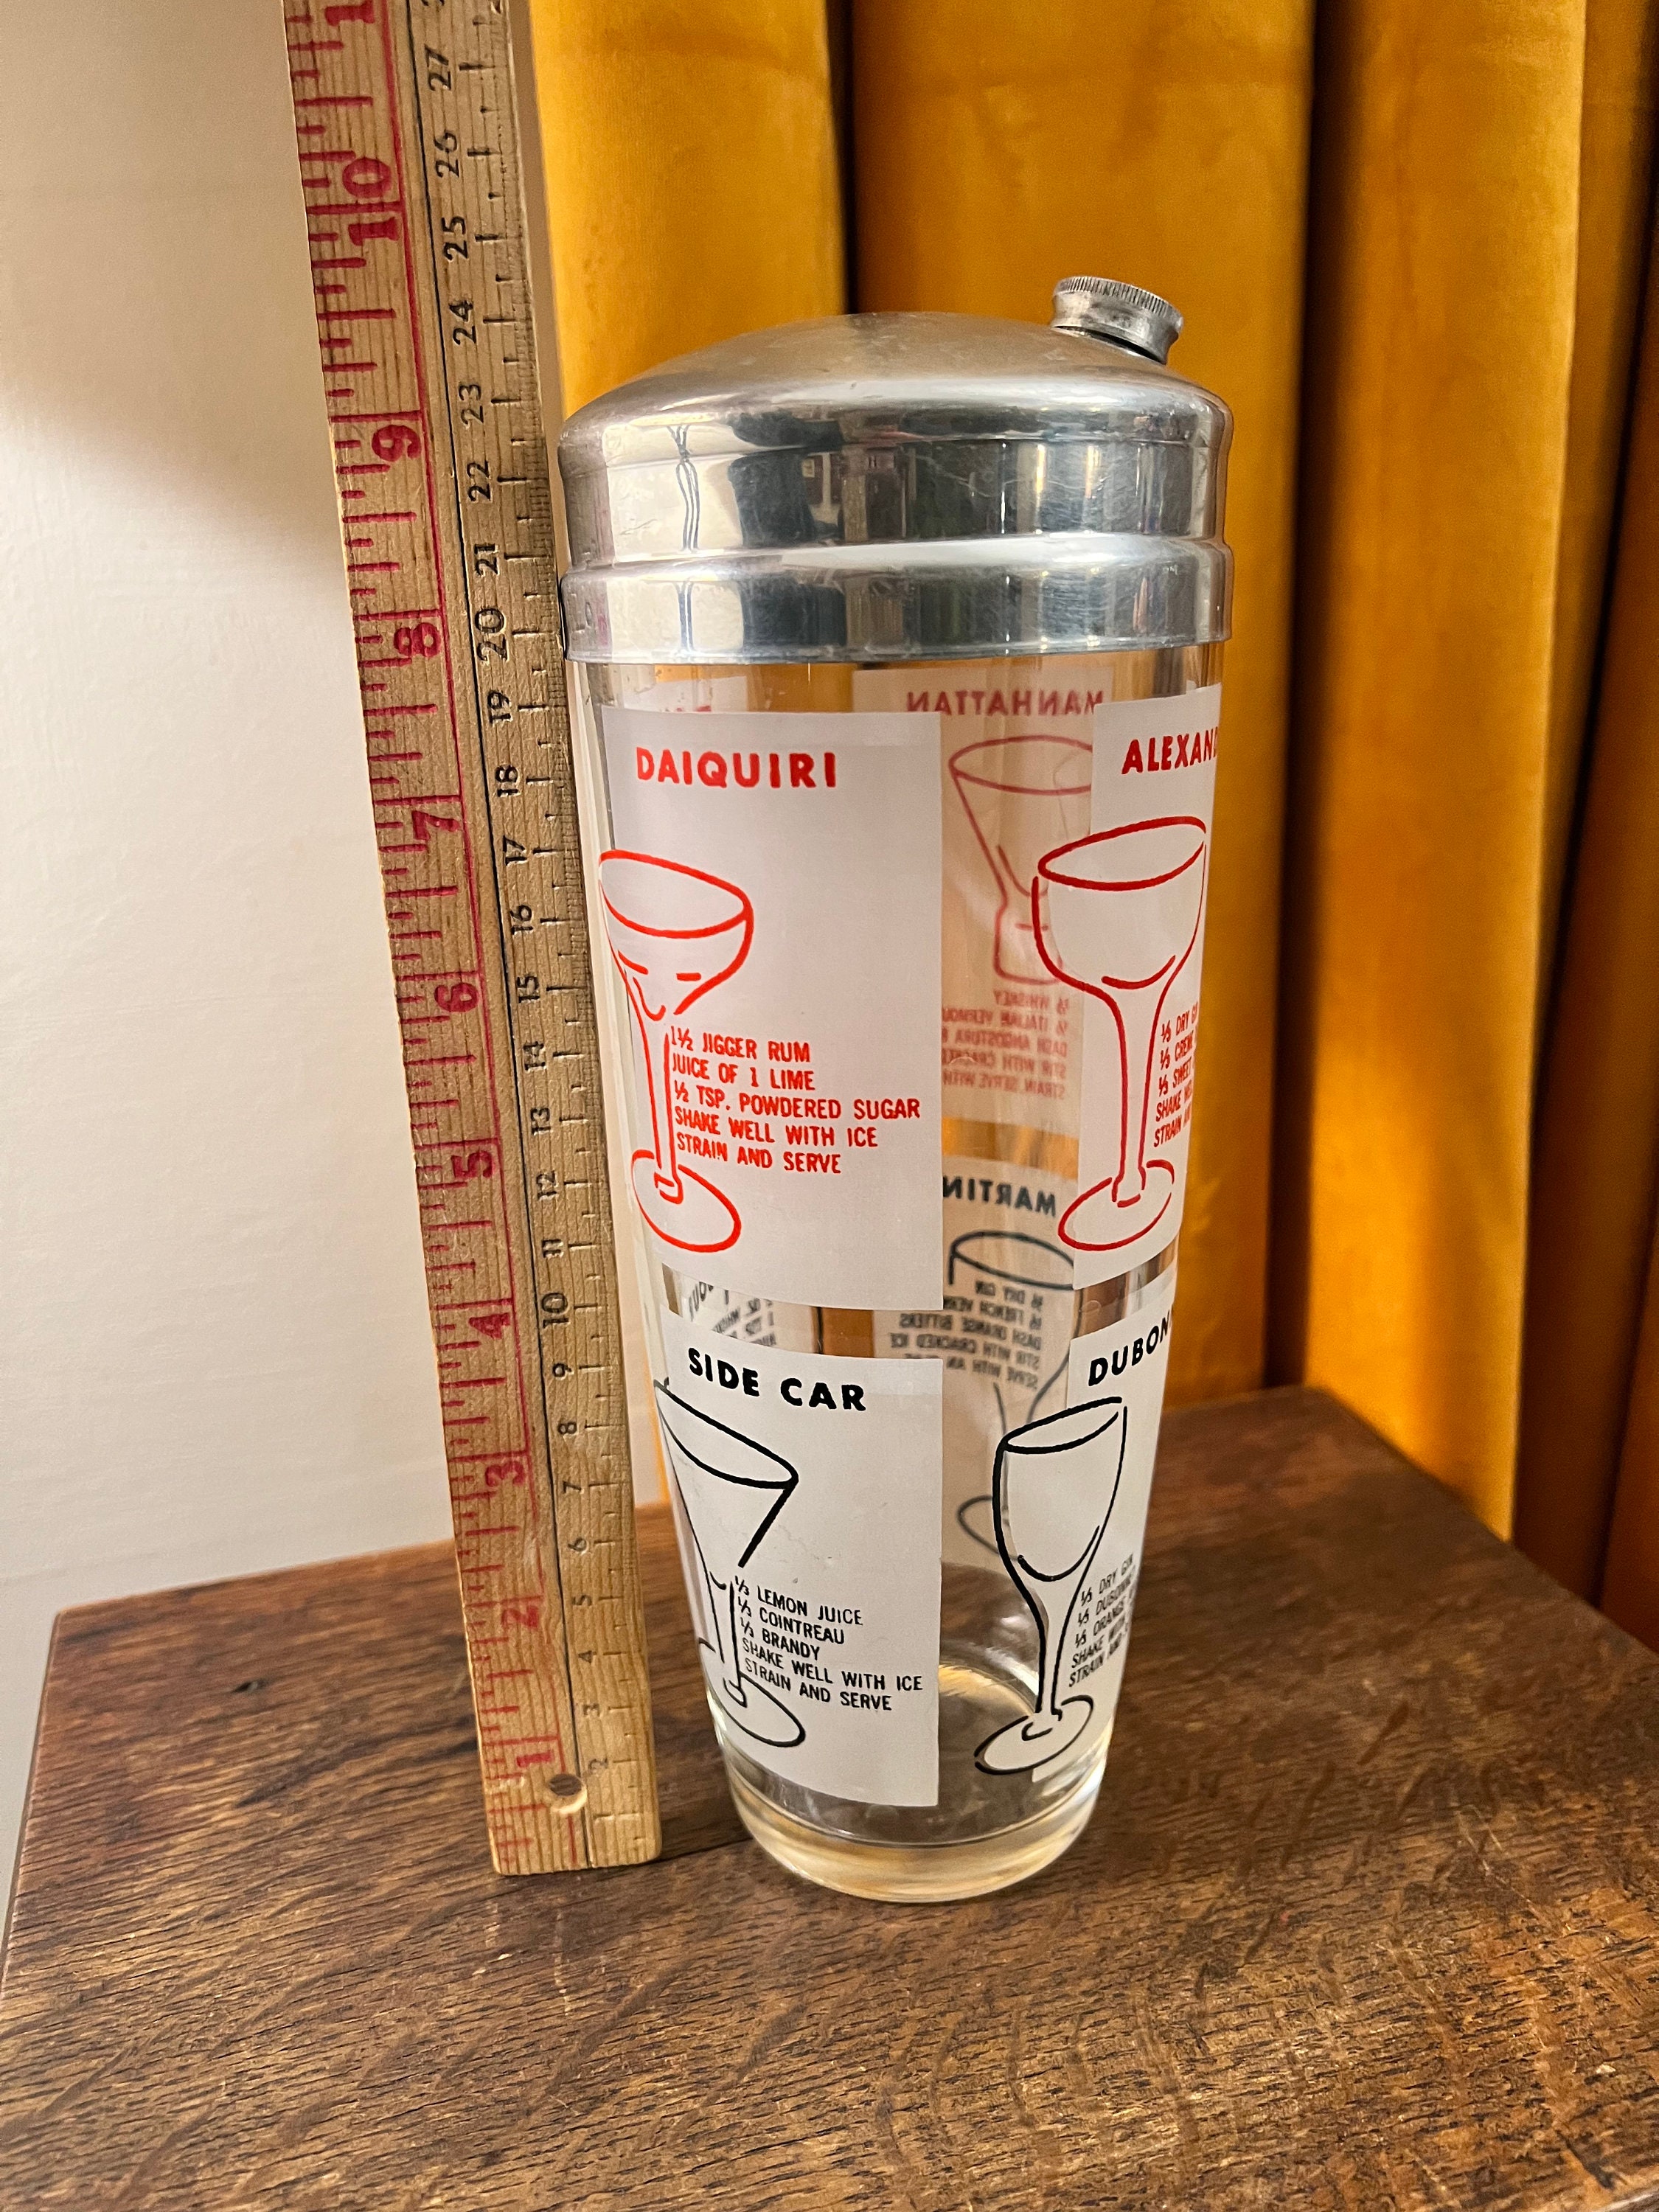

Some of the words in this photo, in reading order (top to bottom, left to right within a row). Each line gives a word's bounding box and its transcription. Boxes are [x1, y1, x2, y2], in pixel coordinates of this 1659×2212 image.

[324, 1, 375, 27] 1
[424, 44, 452, 91] 27
[434, 130, 459, 177] 26
[342, 157, 399, 246] 10
[442, 215, 468, 262] 25
[448, 299, 476, 345] 24
[458, 383, 484, 428] 23
[372, 424, 422, 462] 9
[467, 460, 491, 502] 22
[475, 543, 498, 577] 21
[393, 622, 441, 658] 8
[475, 608, 509, 661] 20
[487, 689, 512, 724] 19
[495, 765, 521, 798] 18
[636, 746, 836, 789] DAIQUIRI
[411, 810, 461, 841] 7
[502, 835, 528, 866] 17
[509, 904, 533, 935] 16
[434, 981, 479, 1013] 6
[517, 975, 540, 1004] 15
[1175, 1009, 1189, 1036] DRY
[523, 1040, 547, 1072] 14
[703, 1032, 757, 1060] JIGGER
[768, 1040, 810, 1062] RUM
[672, 1052, 710, 1080] JUICE
[718, 1063, 738, 1084] OF
[750, 1067, 759, 1088] 1
[770, 1068, 815, 1091] LIME
[696, 1085, 731, 1111] TSP.
[739, 1092, 841, 1119] POWDERED
[853, 1098, 920, 1120] SUGAR
[1155, 1090, 1182, 1122] SHAKE
[530, 1107, 551, 1135] 13
[675, 1105, 720, 1135] SHAKE
[728, 1116, 776, 1144] WELL
[785, 1124, 835, 1147] WITH
[847, 1127, 878, 1147] ICE
[1154, 1114, 1182, 1147] STRAIN
[451, 1150, 494, 1178] 5
[676, 1132, 728, 1162] STRAIN
[737, 1146, 773, 1169] AND
[784, 1151, 841, 1174] SERVE
[537, 1169, 559, 1201] 12
[542, 1238, 564, 1259] 11
[468, 1312, 511, 1340] 4
[541, 1292, 569, 1328] 10
[552, 1362, 573, 1378] 9
[688, 1347, 759, 1397] SIDE
[780, 1377, 866, 1411] CAR
[557, 1422, 577, 1436] 8
[484, 1460, 525, 1487] 3
[563, 1481, 583, 1495] 7
[568, 1537, 588, 1553] 6
[1099, 1568, 1118, 1594] DRY
[501, 1605, 540, 1630] 2
[572, 1595, 593, 1607] 5
[757, 1585, 807, 1617] LEMON
[817, 1605, 863, 1626] JUICE
[759, 1607, 845, 1645] COINTREAU
[577, 1649, 597, 1663] 4
[762, 1627, 820, 1660] BRANDY
[1071, 1635, 1105, 1668] SHAKE
[742, 1637, 785, 1669] SHAKE
[791, 1660, 834, 1684] WELL
[841, 1671, 885, 1691] WITH
[897, 1675, 924, 1691] ICE
[1069, 1651, 1105, 1687] STRAIN
[745, 1658, 792, 1692] STRAIN
[799, 1682, 831, 1703] AND
[840, 1691, 893, 1712] SERVE
[582, 1704, 601, 1716] 3
[516, 1751, 554, 1767] 1
[590, 1758, 610, 1770] 2
